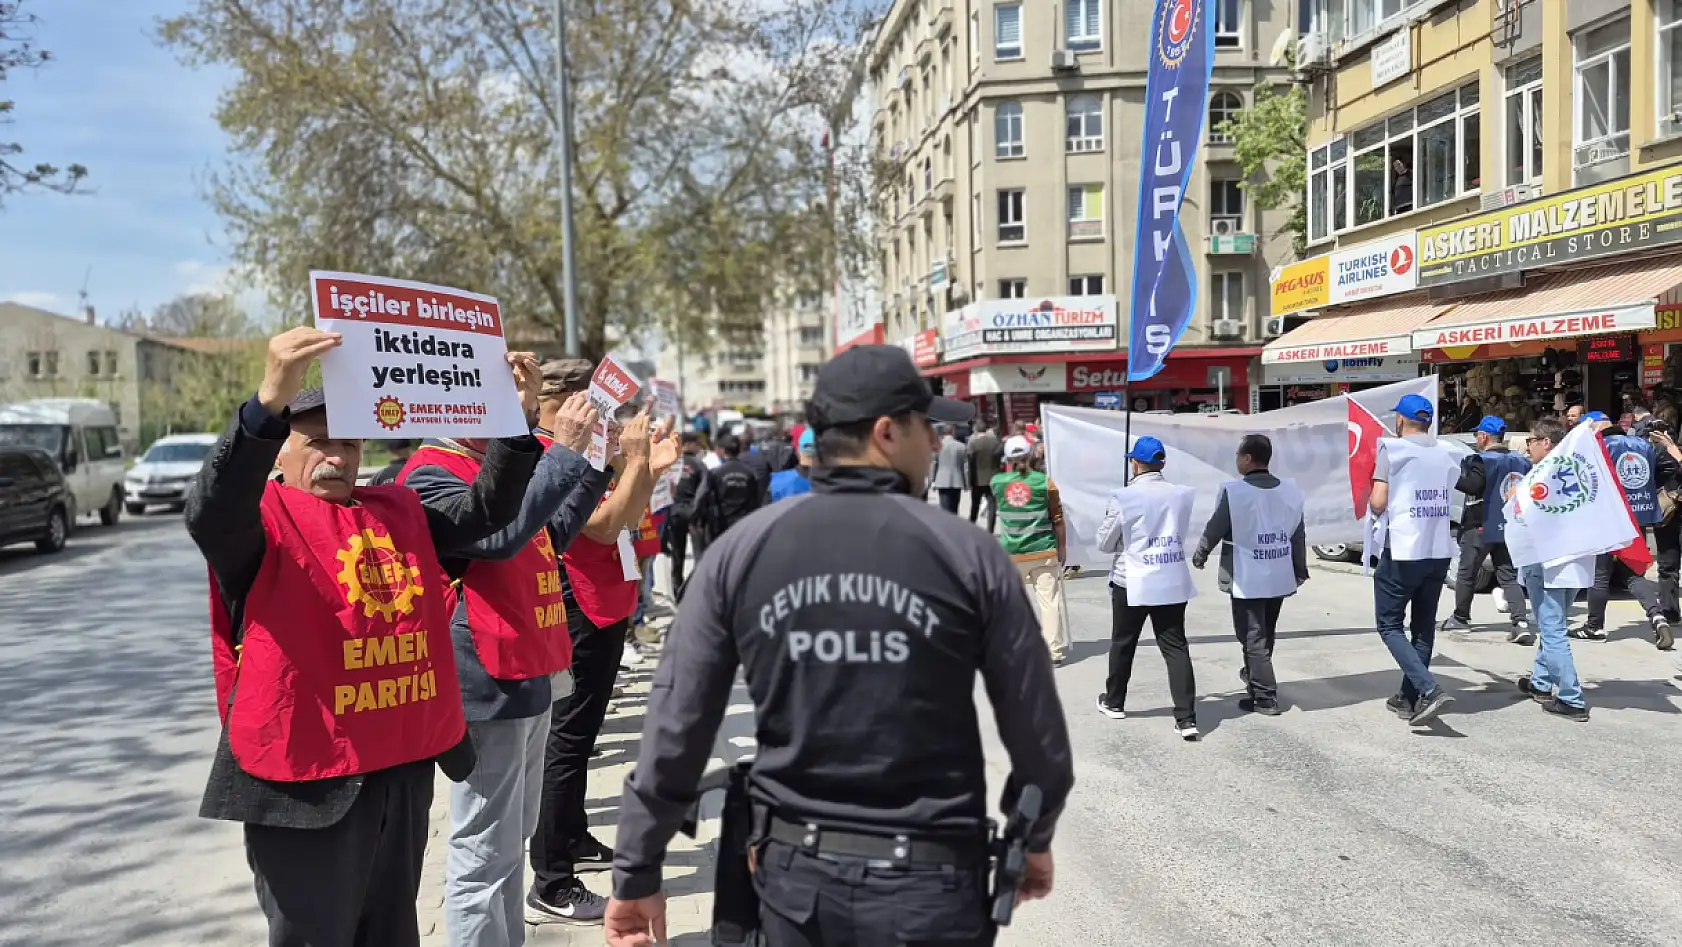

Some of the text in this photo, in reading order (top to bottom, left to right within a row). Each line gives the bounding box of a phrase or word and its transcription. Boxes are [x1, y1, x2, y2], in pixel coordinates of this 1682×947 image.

[1338, 251, 1388, 272] TURKISH
[1455, 223, 1651, 275] TACTICAL STORE
[1275, 271, 1325, 295] PEGASUS
[1338, 265, 1388, 286] AIRLINES
[329, 286, 495, 330] işçiler birleşin
[1053, 309, 1104, 324] TURİZM
[1436, 314, 1617, 345] ASKERİ MALZEME
[374, 328, 475, 359] iktidara
[1277, 342, 1389, 361] ASKERİ MALZEME
[371, 363, 482, 391] yerleşin!
[1072, 365, 1127, 388] Setu
[409, 403, 443, 415] EMEK
[361, 563, 407, 584] EMEP
[536, 570, 562, 596] EME
[838, 572, 941, 638] KUVVET
[343, 629, 429, 671] EMEK
[334, 661, 437, 716] PARTİSİ
